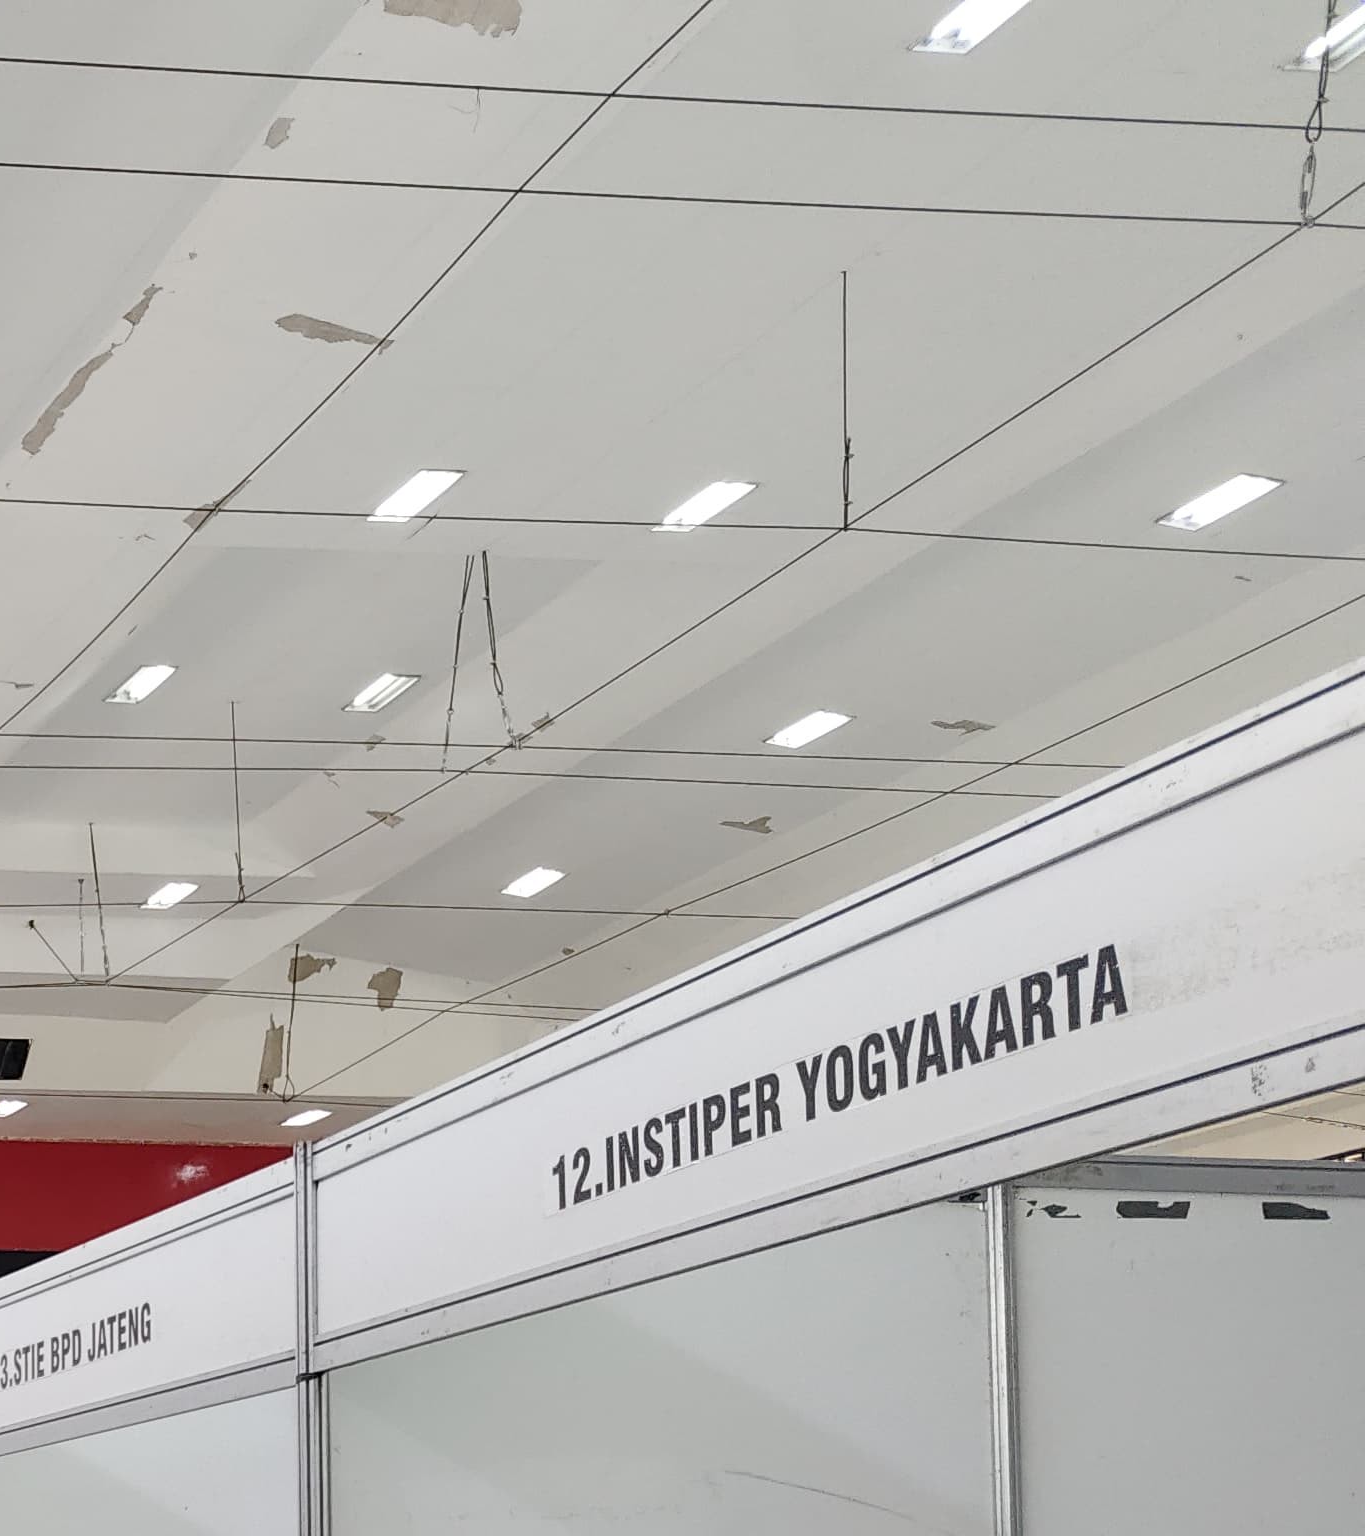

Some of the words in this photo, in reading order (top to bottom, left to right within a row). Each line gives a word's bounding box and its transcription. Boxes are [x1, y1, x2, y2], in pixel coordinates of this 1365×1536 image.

[552, 1073, 782, 1210] 12.INSTIPER
[796, 943, 1129, 1122] YOGYAKARTA
[50, 1329, 82, 1375] BPD
[87, 1302, 152, 1363] JATENG
